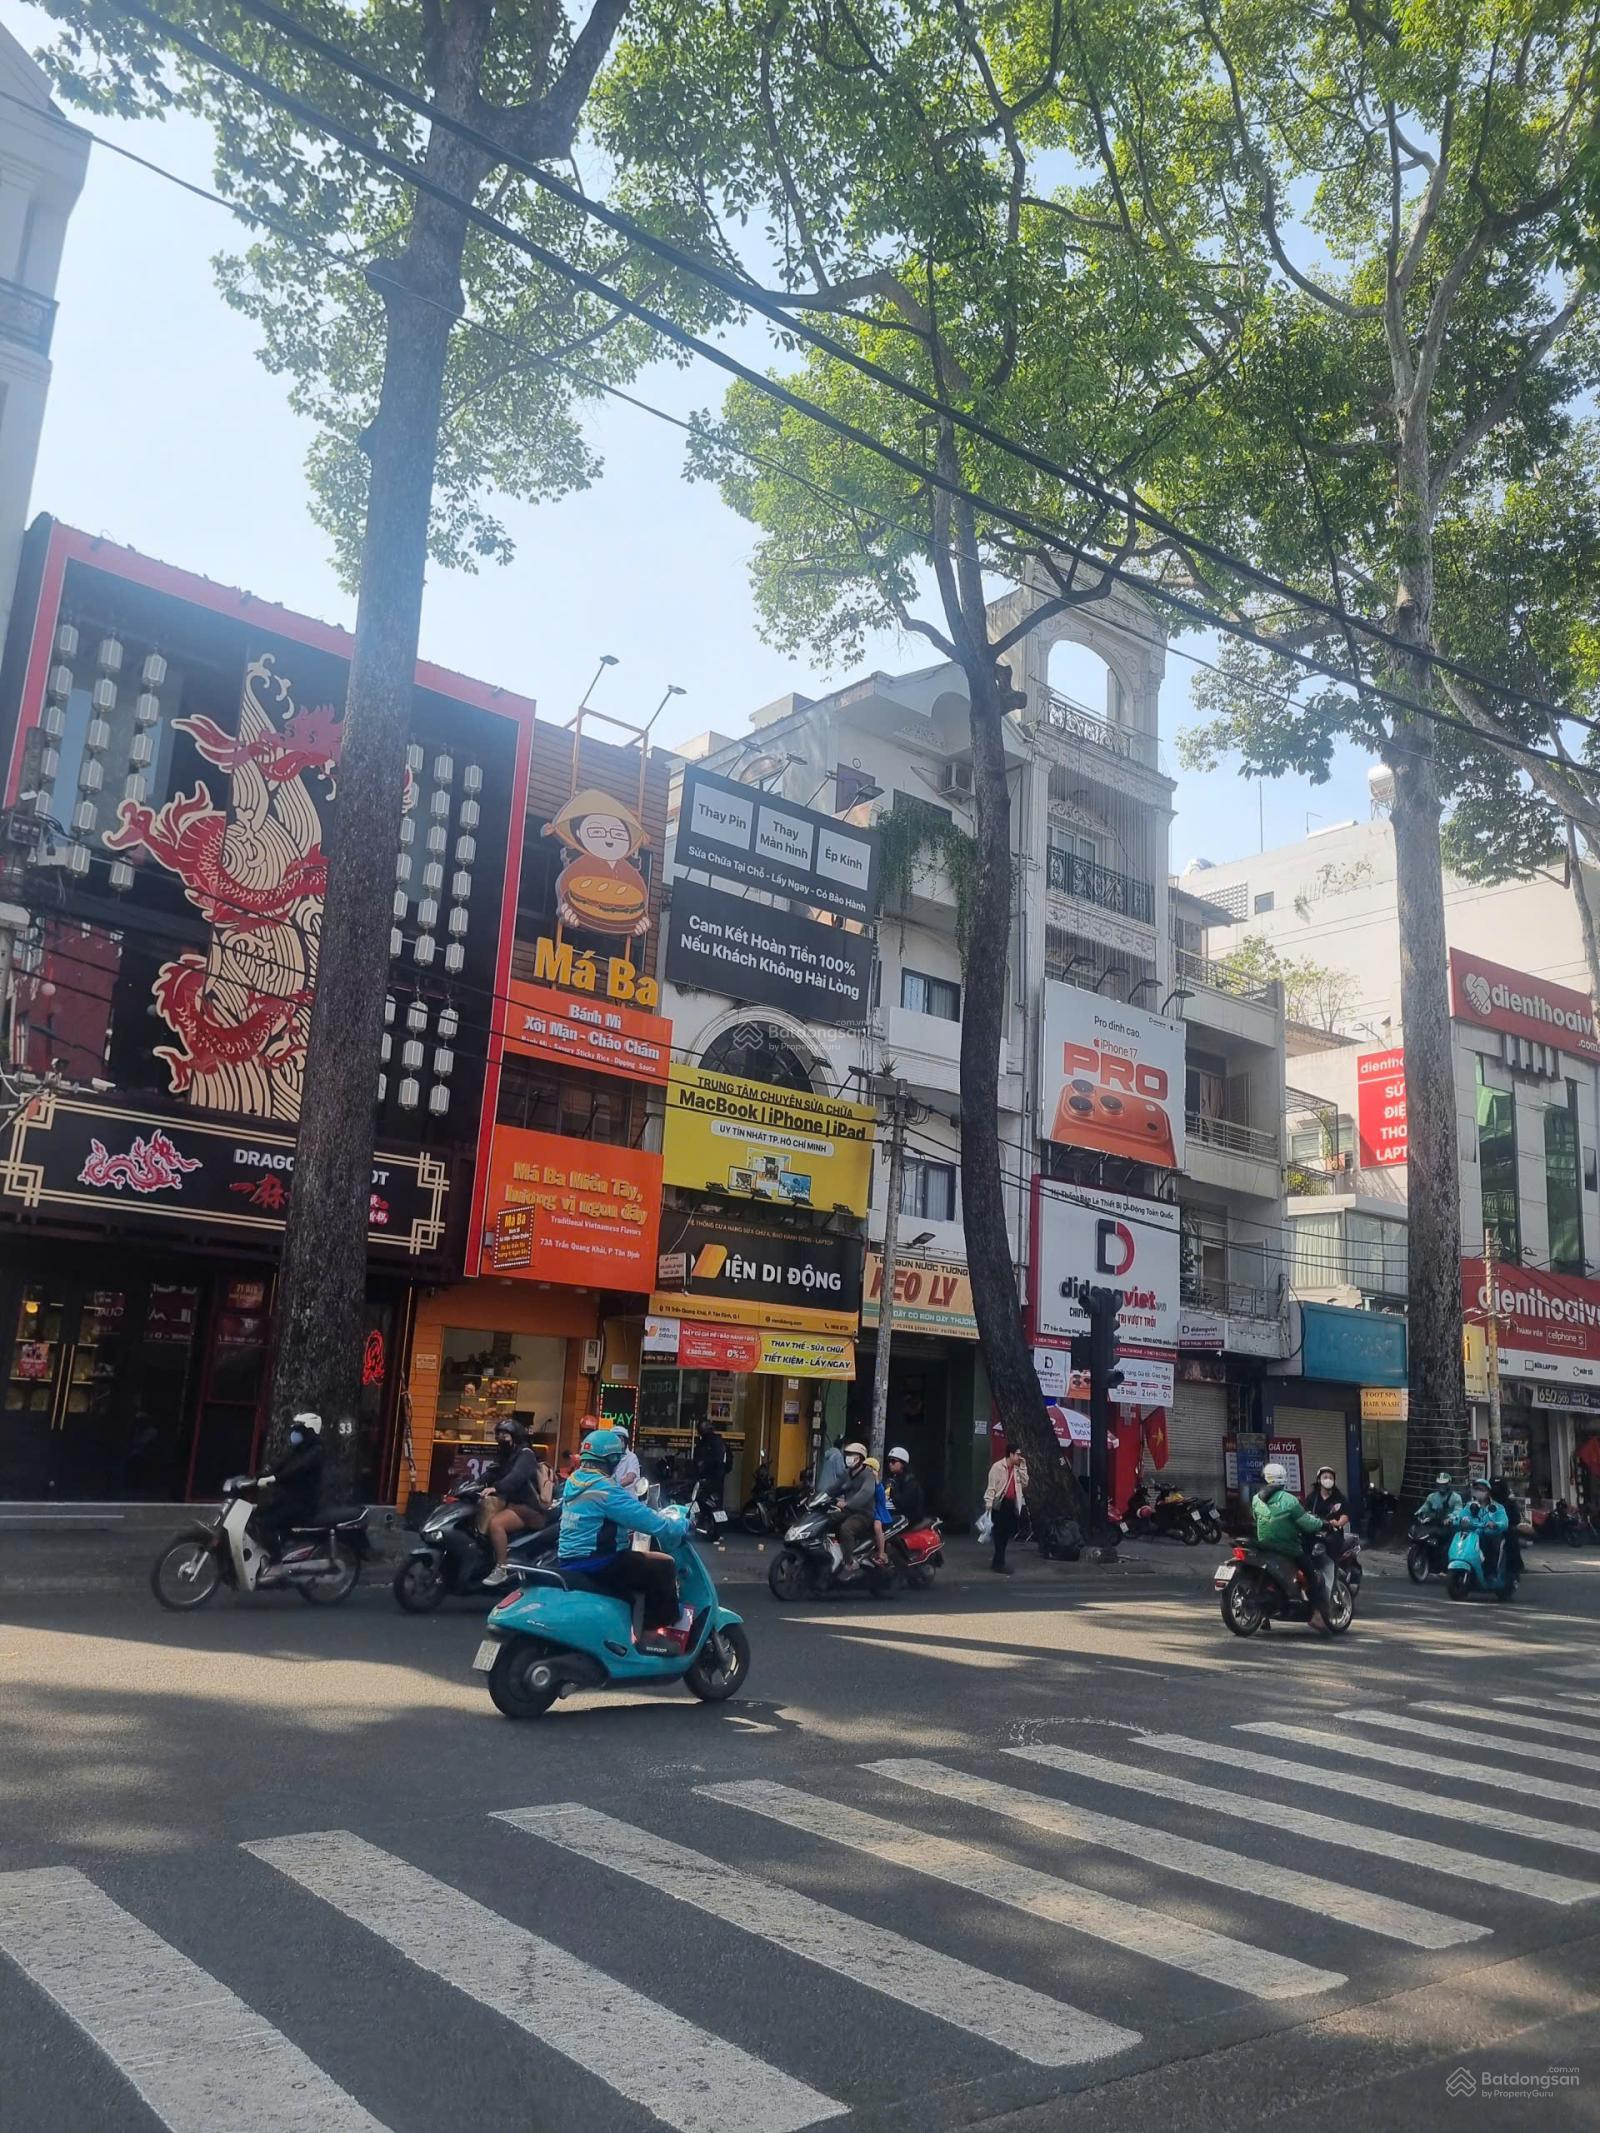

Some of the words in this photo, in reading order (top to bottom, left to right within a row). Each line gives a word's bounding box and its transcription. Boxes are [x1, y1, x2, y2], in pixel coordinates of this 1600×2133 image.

[698, 803, 727, 825] Thay
[729, 815, 747, 830] Pin
[772, 821, 800, 841] Thay
[760, 832, 783, 853] Màn
[825, 845, 839, 864] Ép
[688, 845, 707, 860] Sửa
[708, 852, 732, 868] Chữa
[733, 860, 746, 874] Tại
[747, 863, 765, 880] Chỗ
[771, 872, 786, 888] Lấy
[787, 878, 810, 895] Ngay
[828, 891, 845, 906] Bảo
[845, 898, 867, 913] Hành
[689, 915, 722, 937] Cam
[724, 925, 748, 945] Kết
[750, 933, 787, 957] Hoàn
[789, 944, 817, 966] Tiền
[819, 954, 856, 977] 100%
[534, 936, 597, 992] Má
[606, 956, 659, 1008] Ba
[681, 934, 711, 956] Nếu
[712, 942, 757, 968] Khách
[759, 956, 802, 984] Không
[805, 970, 827, 988] Hài
[829, 976, 860, 1000] Lòng
[569, 1004, 602, 1025] Bánh
[1491, 984, 1594, 1036] dienthoaiv
[1094, 1015, 1108, 1029] Pro
[524, 1015, 547, 1034] Xôi
[550, 1021, 577, 1042] Mặn
[624, 1039, 660, 1060] Chấm
[1100, 1039, 1128, 1057] iPhone
[614, 1057, 636, 1069] Dipping
[638, 1063, 656, 1073] Sauce
[1064, 1041, 1168, 1101] PRO
[698, 1077, 734, 1094] TRUNG
[737, 1083, 759, 1100] TÂM
[760, 1089, 802, 1108] CHUYÊN
[804, 1097, 825, 1114] SỬA
[826, 1102, 854, 1119] CHỮA
[1385, 1081, 1407, 1099] SỬ
[679, 1088, 760, 1121] MacBook
[768, 1106, 823, 1134] iPhone
[833, 1119, 866, 1140] iPad
[1384, 1106, 1407, 1121] ĐIỆ
[719, 1124, 731, 1134] UY
[732, 1125, 746, 1137] TÍN
[747, 1127, 769, 1141] NHẤT
[769, 1133, 780, 1145] TP.
[780, 1134, 793, 1147] HỒ
[793, 1137, 806, 1150] CHÍ
[807, 1141, 827, 1153] MINH
[1380, 1126, 1408, 1141] THO
[234, 1149, 295, 1171] DRAGO
[1376, 1146, 1408, 1162] LAPT
[513, 1161, 541, 1182] Má
[543, 1167, 567, 1187] Ba
[569, 1170, 609, 1195] Miền
[610, 1177, 644, 1202] Tây,
[561, 1196, 577, 1216] vị
[579, 1201, 618, 1219] ngon
[620, 1202, 648, 1225] đây
[1100, 1198, 1115, 1208] Thiết
[1146, 1208, 1159, 1217] Toàn
[1159, 1210, 1174, 1220] Quốc
[550, 1215, 584, 1228] Traditional
[585, 1220, 620, 1233] Vietnamese
[555, 1239, 569, 1249] Trần
[571, 1242, 591, 1253] Quang
[762, 1264, 782, 1284] DI
[787, 1263, 842, 1292] ĐỘNG
[1043, 1323, 1050, 1331] 77
[1127, 1314, 1143, 1329] VƯỢT
[771, 1340, 790, 1348] THAY
[792, 1339, 806, 1350] THẾ
[810, 1342, 825, 1352] SỬA
[826, 1344, 844, 1354] CHỮA
[764, 1351, 782, 1362] TIẾT
[782, 1354, 804, 1366] KIỆM
[809, 1355, 827, 1367] LẤY
[826, 1359, 851, 1369] NGAY
[1363, 1400, 1380, 1408] HAIR
[1381, 1400, 1401, 1408] WASH
[1364, 1391, 1383, 1399] FOOT
[1384, 1391, 1398, 1399] SPA
[340, 1422, 352, 1434] 33
[602, 1411, 634, 1427] THAY
[1268, 1440, 1281, 1452] GIÁ
